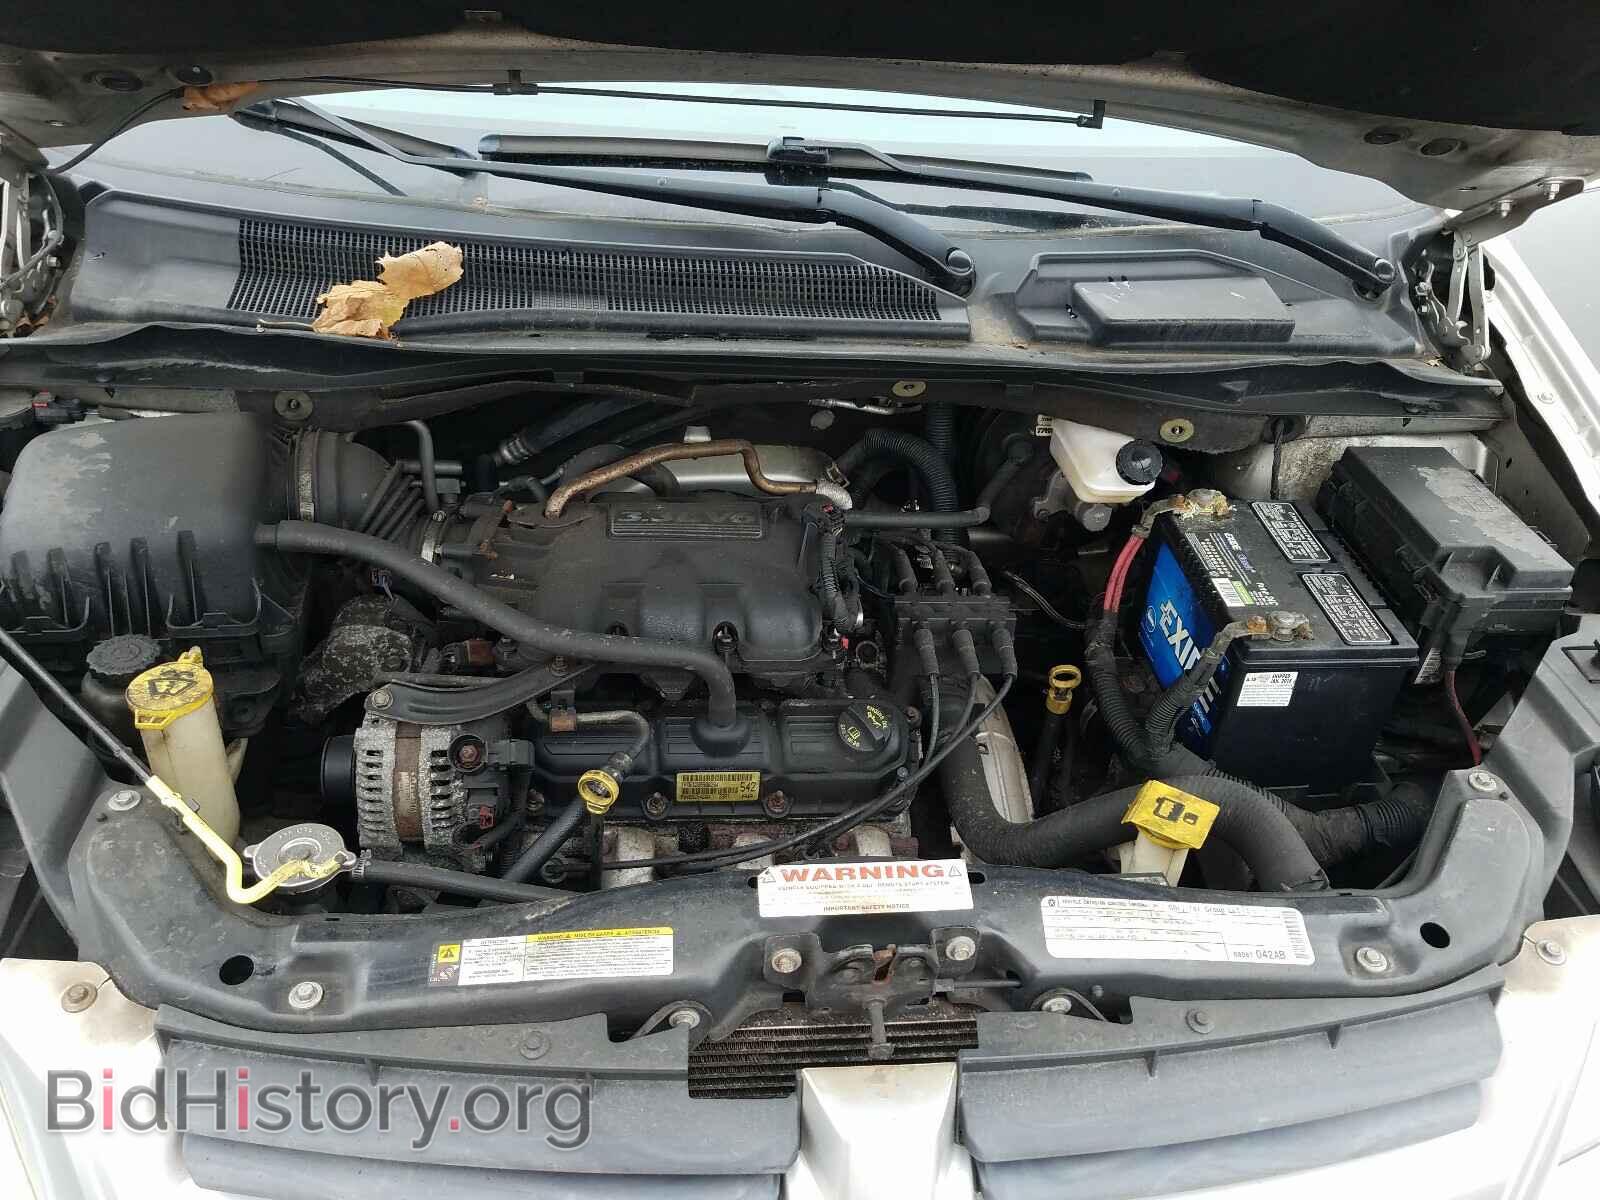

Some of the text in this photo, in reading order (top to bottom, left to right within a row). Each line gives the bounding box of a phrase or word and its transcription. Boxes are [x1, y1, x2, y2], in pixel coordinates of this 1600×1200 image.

[740, 781, 757, 793] 542
[781, 864, 944, 882] WARNING
[1255, 949, 1287, 960] 042AB
